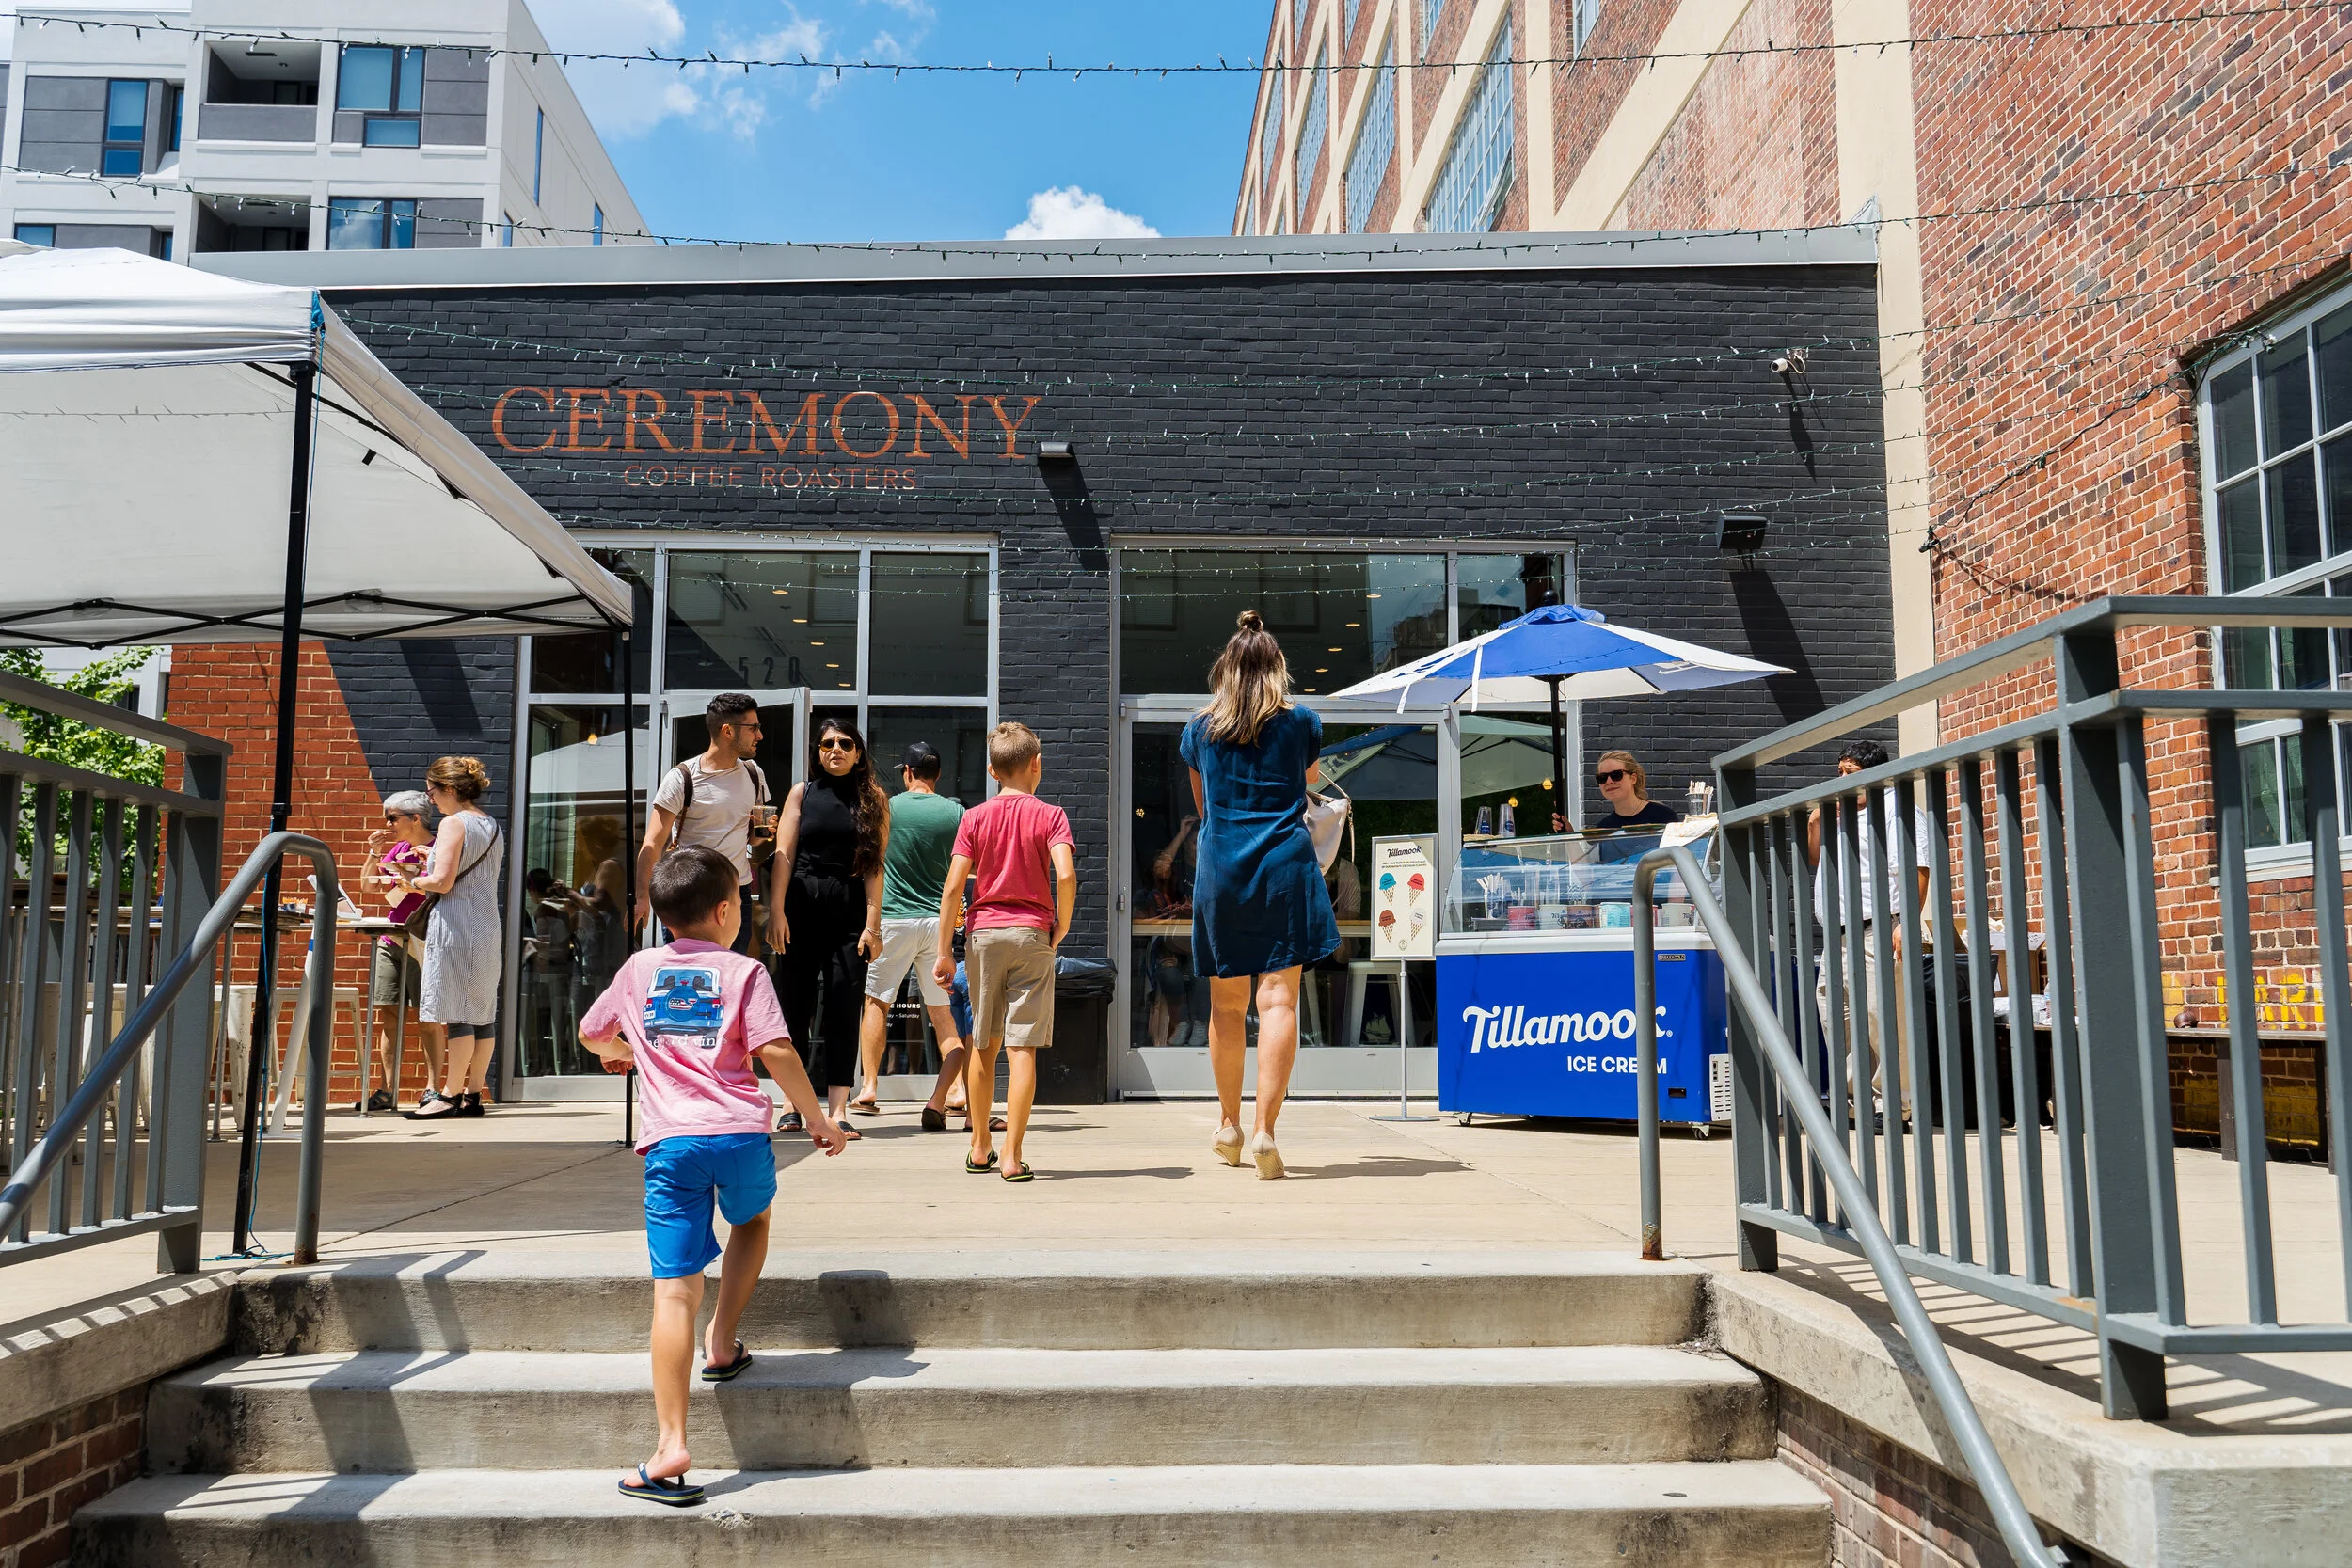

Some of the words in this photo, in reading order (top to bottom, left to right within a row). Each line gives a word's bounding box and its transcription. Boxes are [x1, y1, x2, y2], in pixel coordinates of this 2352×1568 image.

[492, 386, 1042, 459] CEREMONY
[624, 465, 743, 487] COFFEE
[761, 467, 917, 490] ROASTERS
[739, 656, 801, 686] 520
[1387, 845, 1422, 858] Tillamook
[1567, 1055, 1597, 1072] ICE
[1601, 1056, 1667, 1074] CREM
